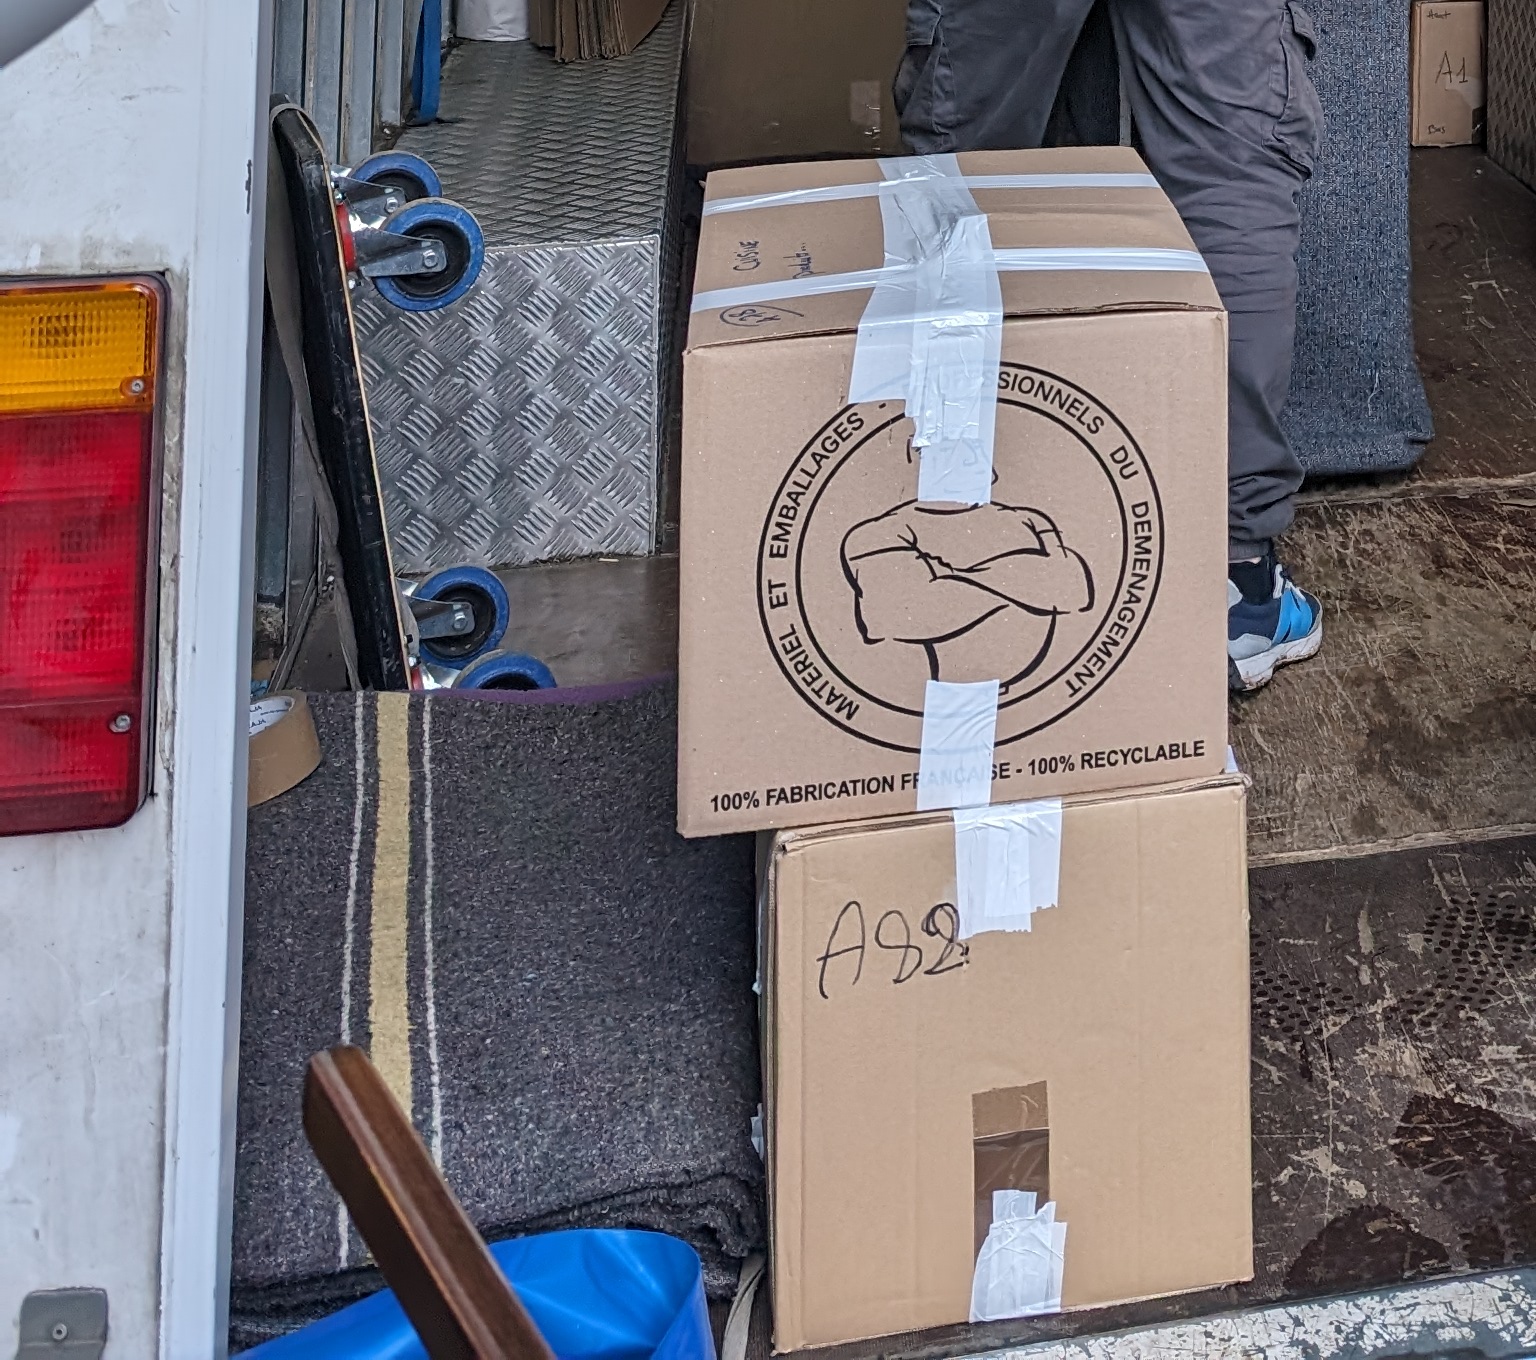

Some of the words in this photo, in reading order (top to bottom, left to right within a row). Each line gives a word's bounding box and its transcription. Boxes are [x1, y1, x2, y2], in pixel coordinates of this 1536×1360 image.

[1434, 50, 1469, 84] A1
[768, 410, 865, 559] EMBALLAGES
[1109, 444, 1140, 482] DU
[768, 578, 790, 610] ET
[1064, 500, 1153, 699] DEMENAGEMENT
[778, 622, 861, 722] MATERIEL
[709, 790, 760, 813] 100%
[765, 774, 896, 807] FABRICATION
[1027, 754, 1076, 777] 100%
[1080, 739, 1206, 771] RECYCLABLE
